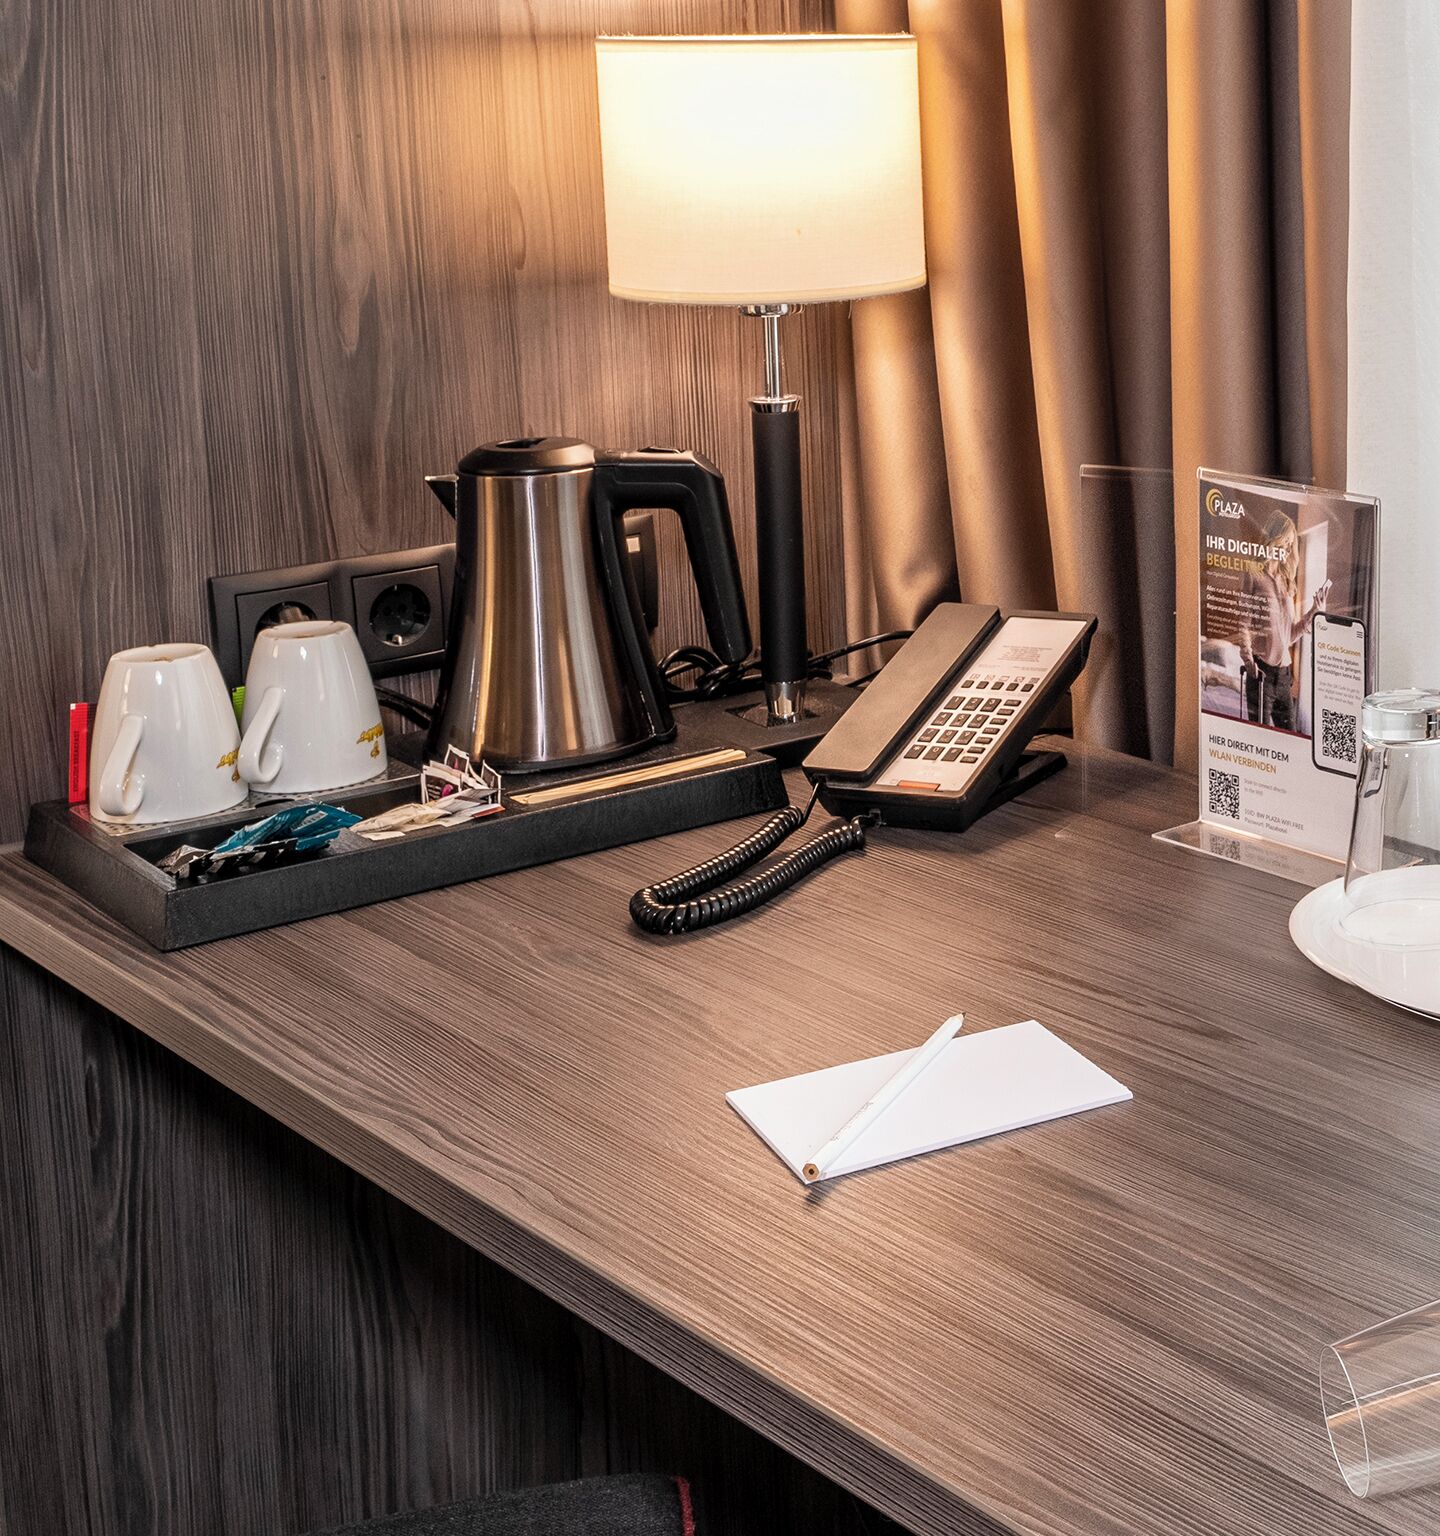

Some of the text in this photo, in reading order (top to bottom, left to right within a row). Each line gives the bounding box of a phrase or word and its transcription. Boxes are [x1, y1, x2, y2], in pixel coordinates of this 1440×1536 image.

[1214, 500, 1246, 516] PLAZA
[1206, 534, 1287, 562] IHR DIGITALER
[1209, 734, 1289, 762] HIER DIREKT MIT DEM
[1209, 748, 1277, 774] WLAN VERBINDEN
